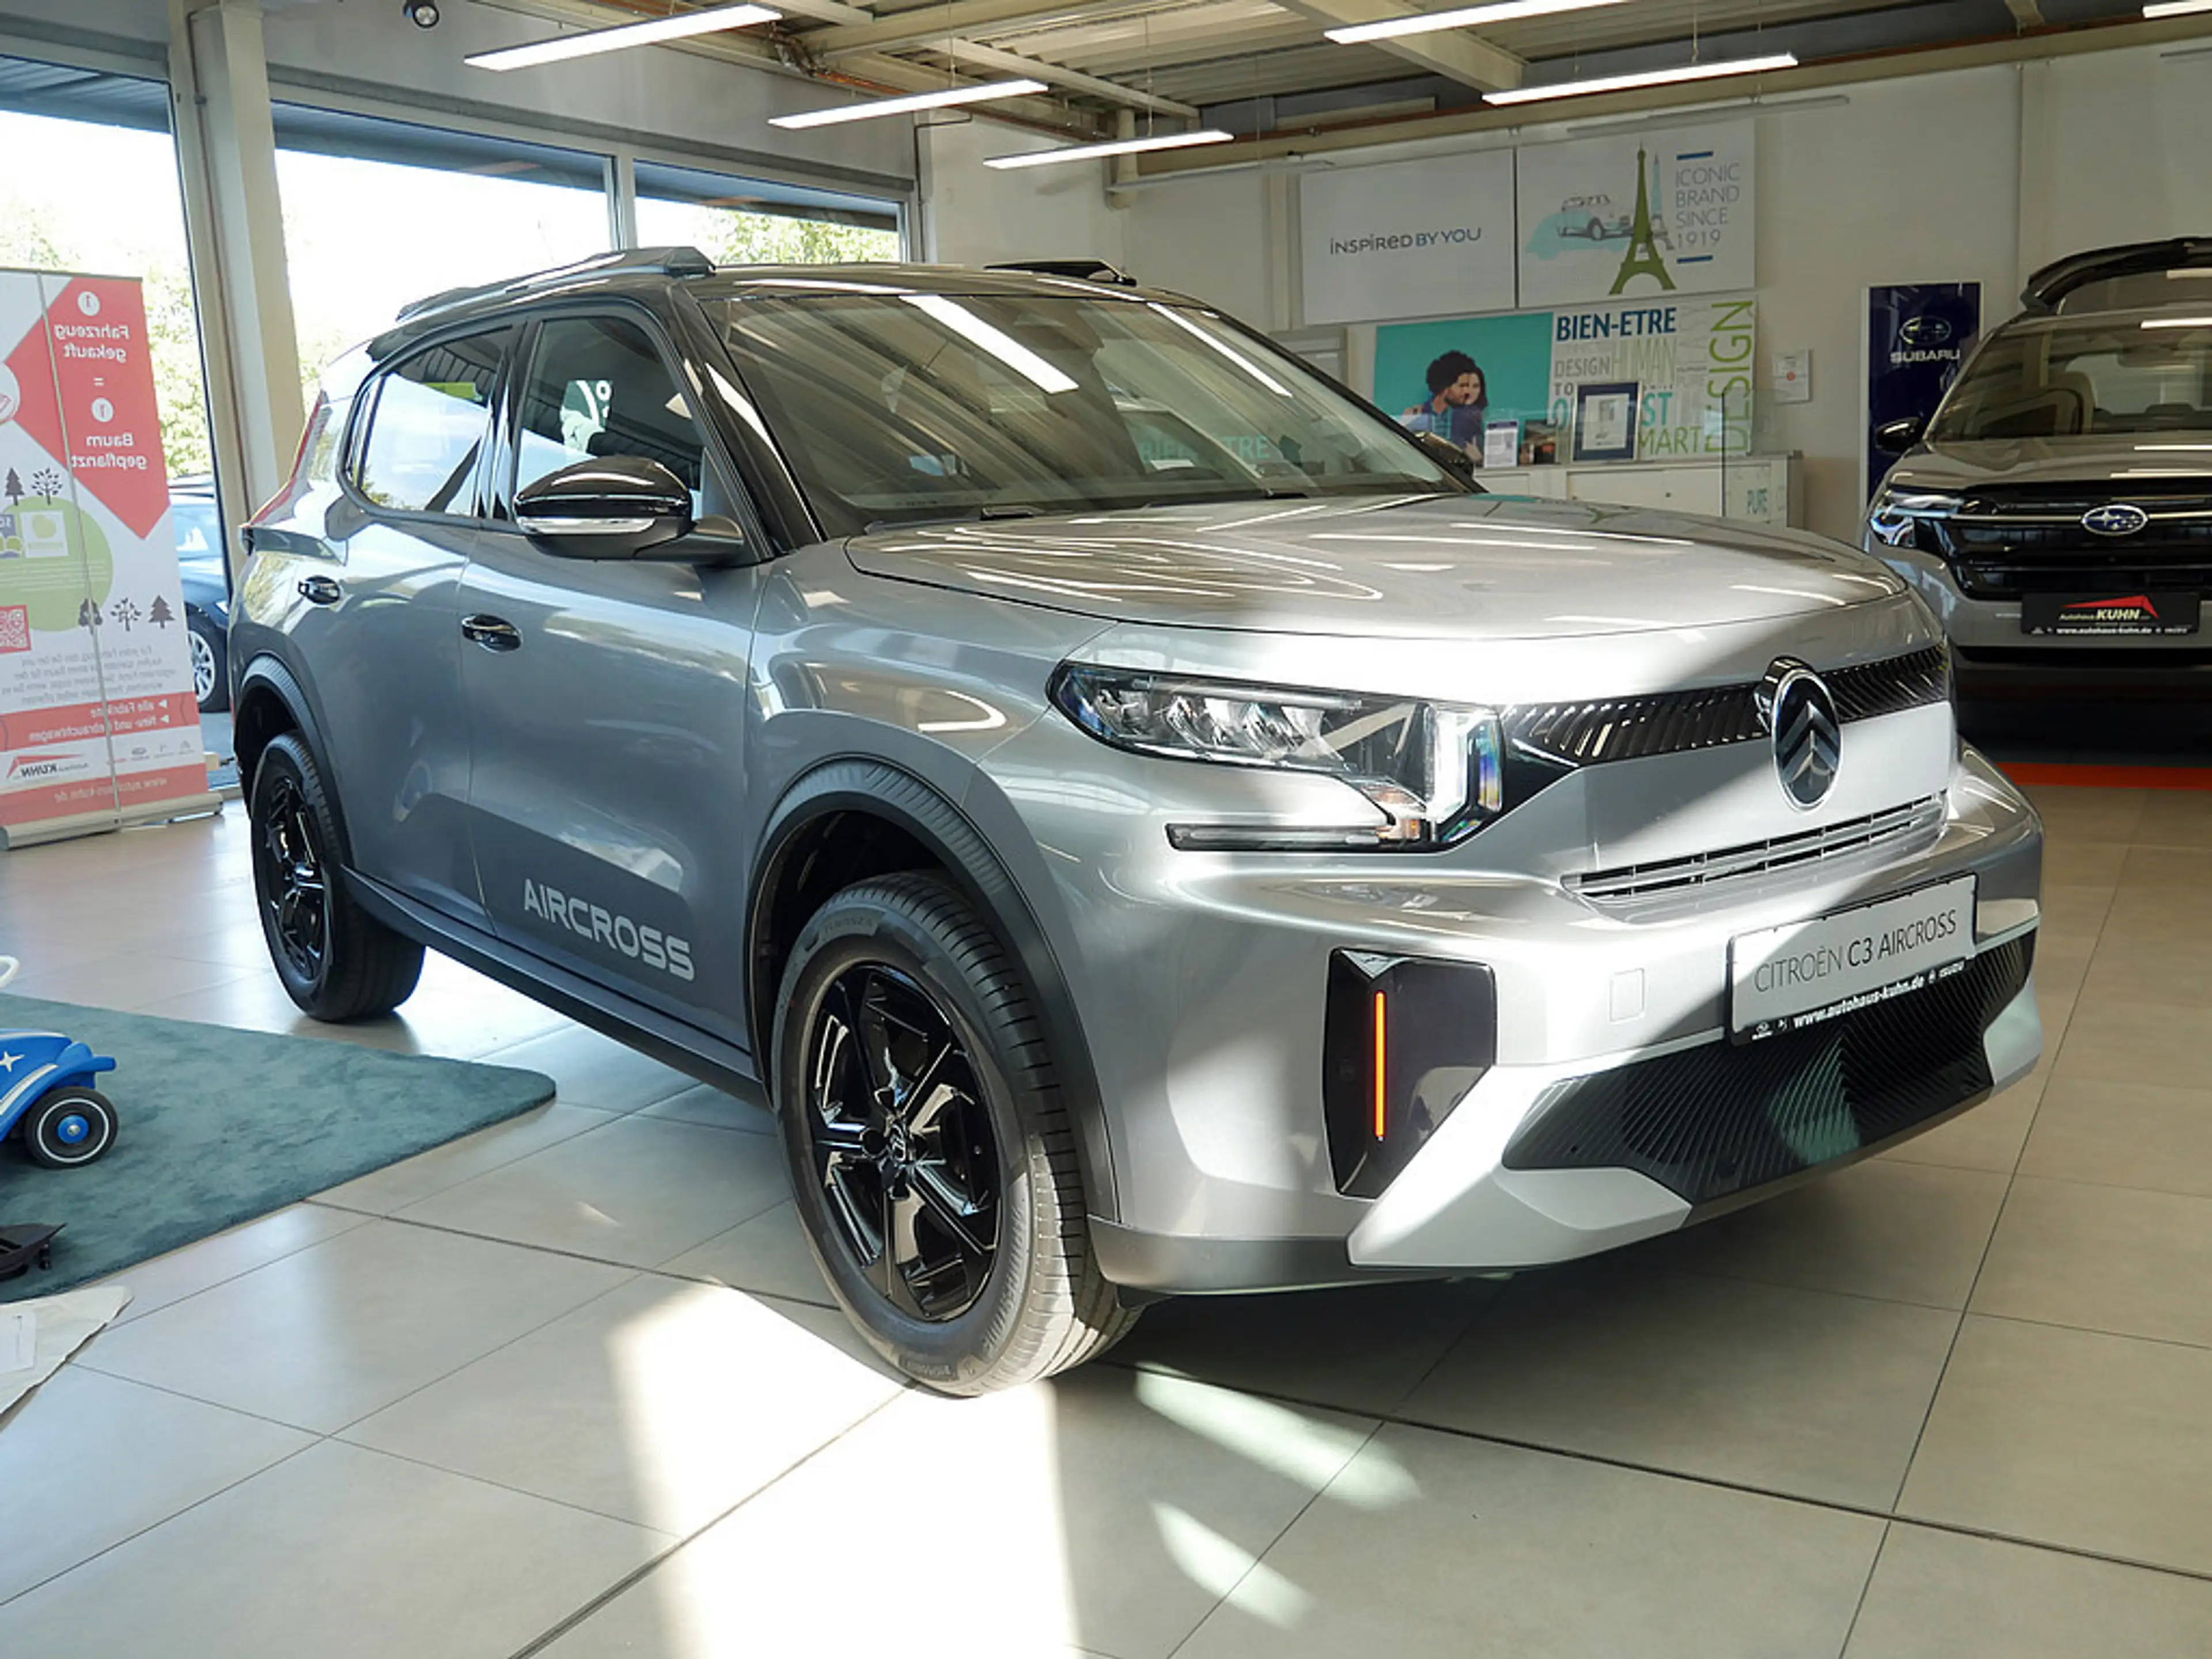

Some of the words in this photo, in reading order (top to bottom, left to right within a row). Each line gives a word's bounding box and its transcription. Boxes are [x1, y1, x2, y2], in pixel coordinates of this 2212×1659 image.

[1676, 162, 1740, 188] ICONIC
[1676, 185, 1740, 208] BRAND
[1676, 206, 1729, 229] SINCE
[1415, 231, 1439, 247] BY
[1441, 227, 1482, 243] YOU
[1677, 229, 1721, 249] 1919
[1556, 307, 1677, 342] BIEN-ETRE
[1556, 356, 1611, 378] DESIGN
[1890, 349, 1961, 363] SUBARU
[2096, 608, 2141, 621] KUHN
[524, 878, 695, 982] AIRCROSS
[1755, 946, 1842, 993] CITROËN
[1847, 937, 1873, 967] C3
[1878, 910, 1957, 961] AIRCROSS
